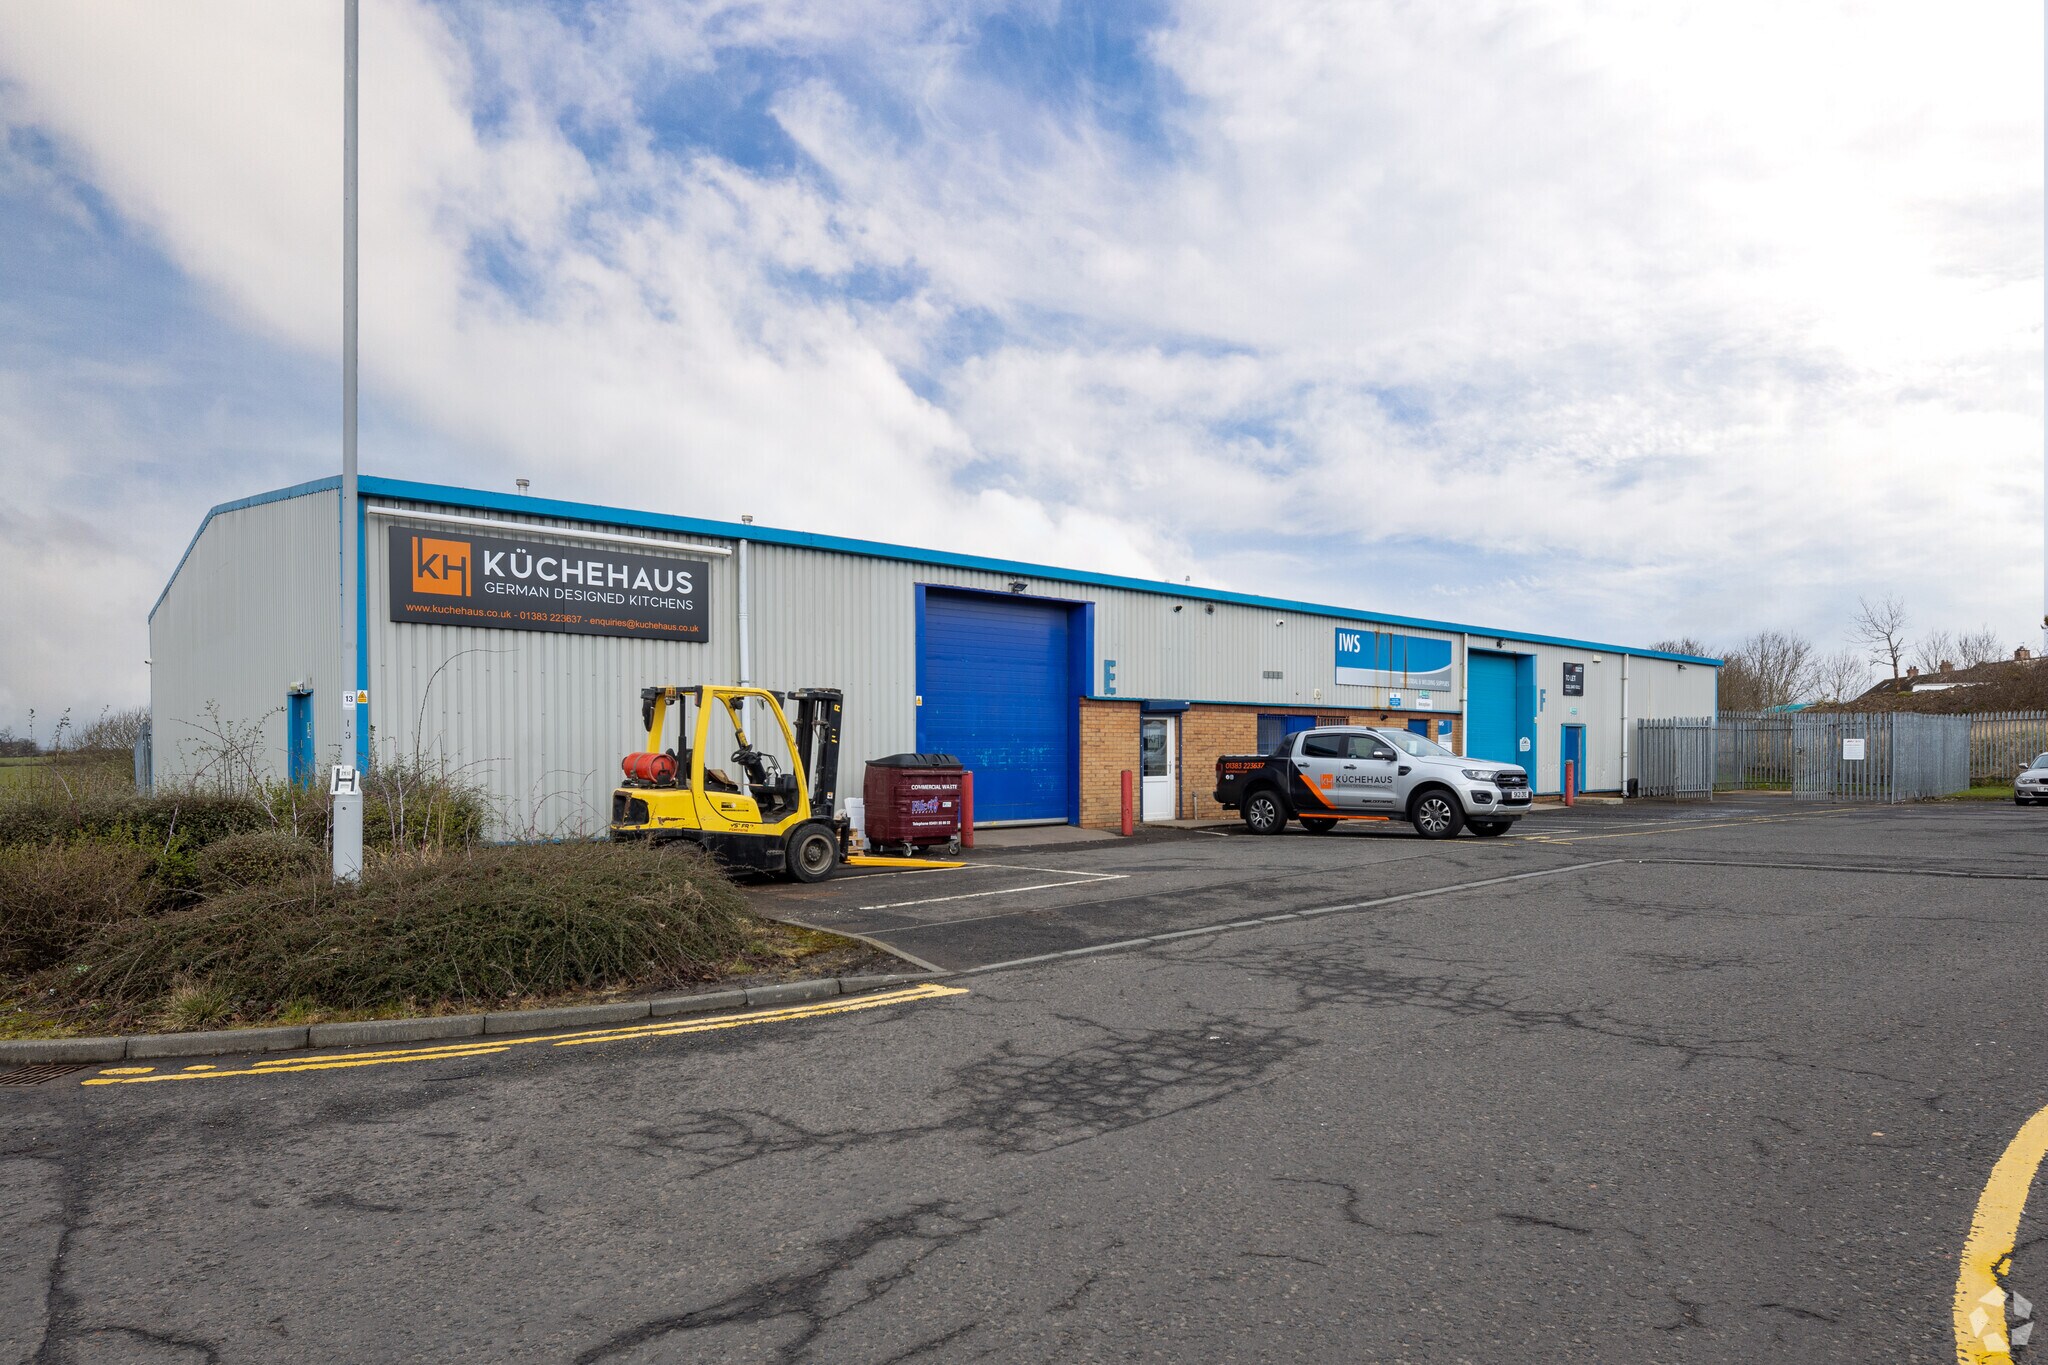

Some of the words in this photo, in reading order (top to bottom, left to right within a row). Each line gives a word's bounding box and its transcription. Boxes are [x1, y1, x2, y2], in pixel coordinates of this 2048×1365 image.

[416, 537, 468, 596] KH
[484, 548, 693, 594] KÜCHEHAUS
[484, 582, 549, 598] GERMAN
[554, 588, 625, 605] DESIGNED
[629, 595, 693, 610] KITCHENS
[406, 604, 512, 618] www.kuchehaus.co.uk
[519, 611, 548, 621] 01383
[550, 613, 582, 624] 223637
[590, 618, 699, 632] enquiries@kuchehaus.co.uk
[1339, 633, 1361, 653] IWS
[1104, 659, 1116, 695] E
[1225, 762, 1242, 770] 01383
[1335, 774, 1393, 784] KÜCHEHAUS
